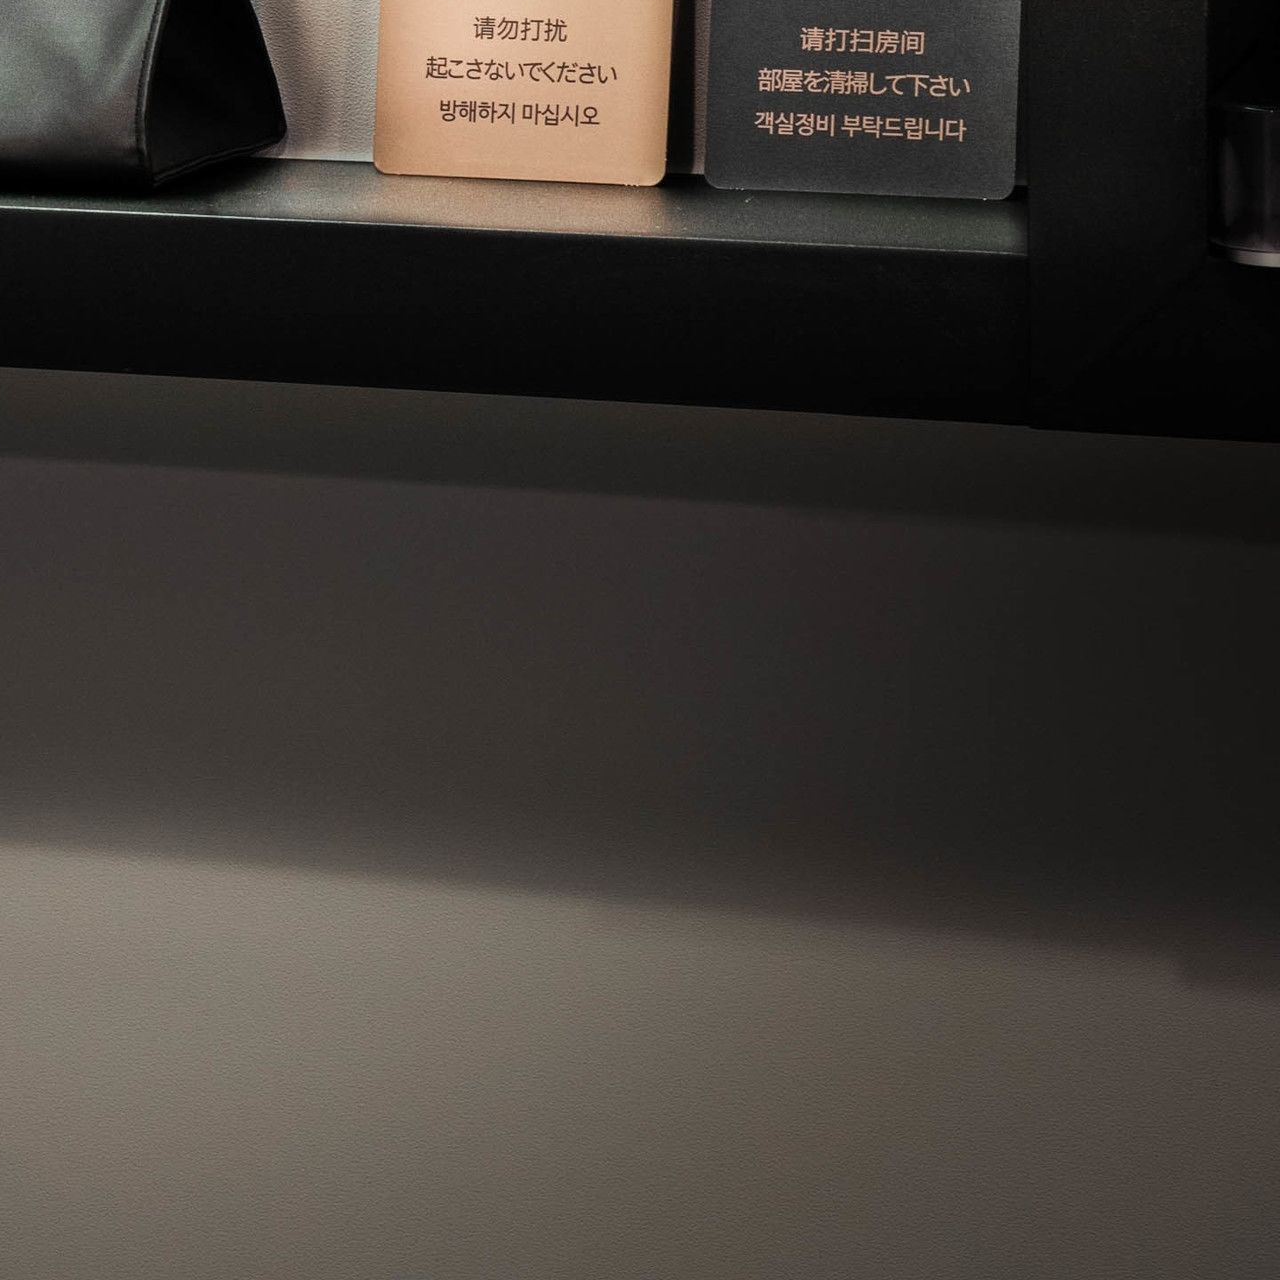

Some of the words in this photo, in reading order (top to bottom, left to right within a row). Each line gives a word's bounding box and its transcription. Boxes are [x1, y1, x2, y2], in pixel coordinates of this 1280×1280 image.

[474, 16, 567, 42] 请勿打扰
[800, 27, 925, 55] 请打扫房间
[425, 55, 618, 84] 起こさないでください
[757, 67, 970, 97] 部屋を清掃して下さい
[440, 100, 515, 124] 방해하지
[522, 103, 600, 127] 마십시오
[754, 111, 835, 137] 객실정비
[841, 114, 967, 142] 부탁드립니다
